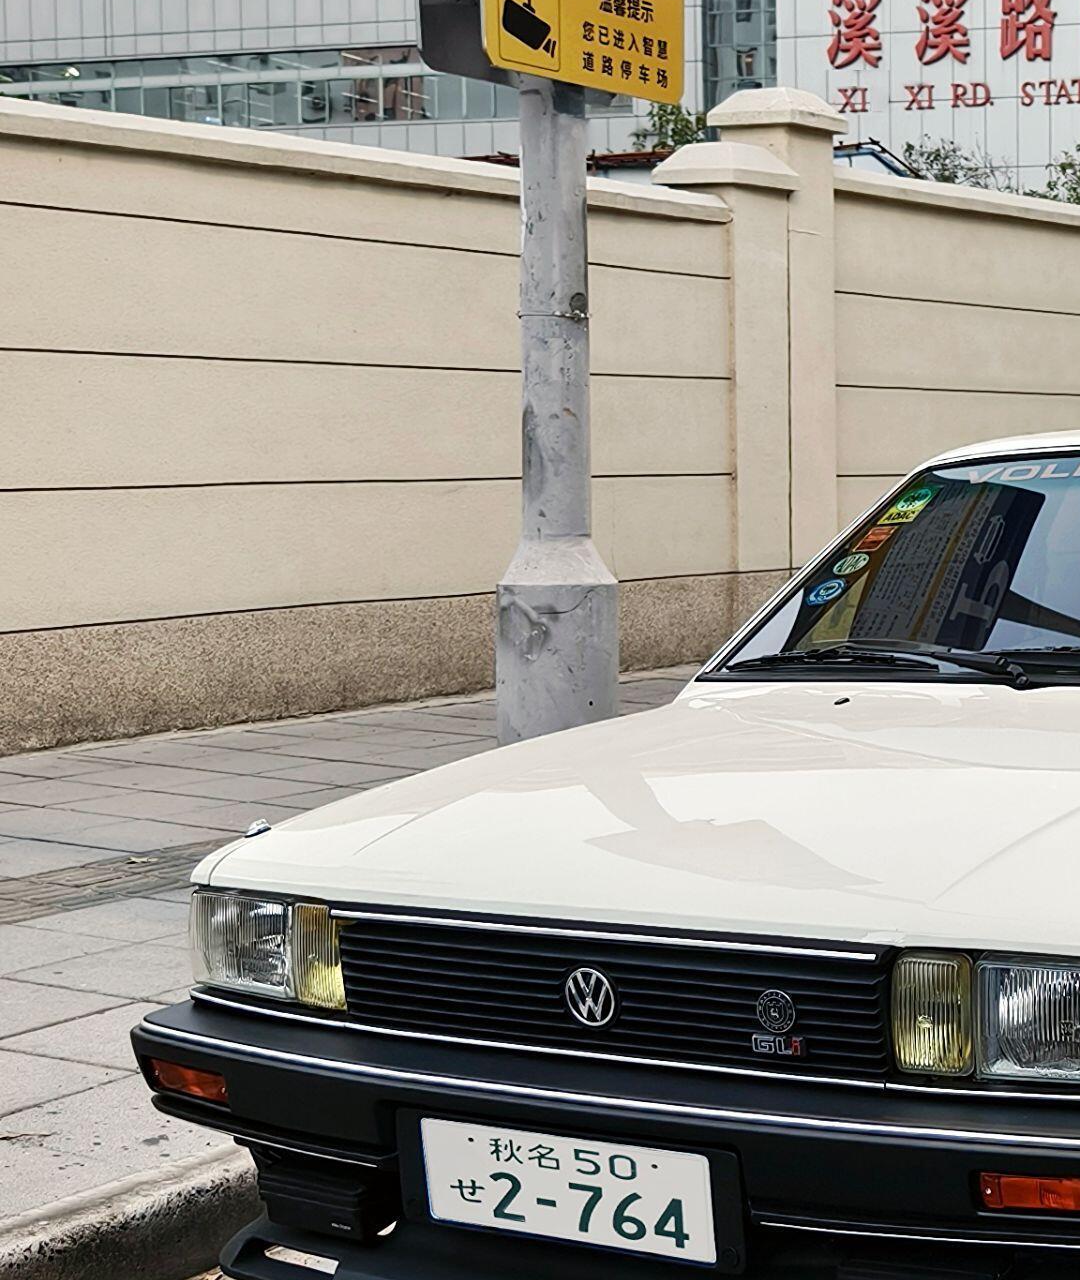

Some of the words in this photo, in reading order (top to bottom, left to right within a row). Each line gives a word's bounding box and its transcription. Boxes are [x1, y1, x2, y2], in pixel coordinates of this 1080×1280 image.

[582, 21, 668, 60] 您已进入智慧
[582, 51, 668, 89] 道路停车场
[838, 87, 869, 113] XI
[904, 84, 935, 110] XI
[951, 82, 995, 108] RD.
[488, 1138, 561, 1171] 秋名
[573, 1148, 638, 1180] 50
[450, 1178, 486, 1204] せ
[489, 1171, 690, 1249] 2-764
